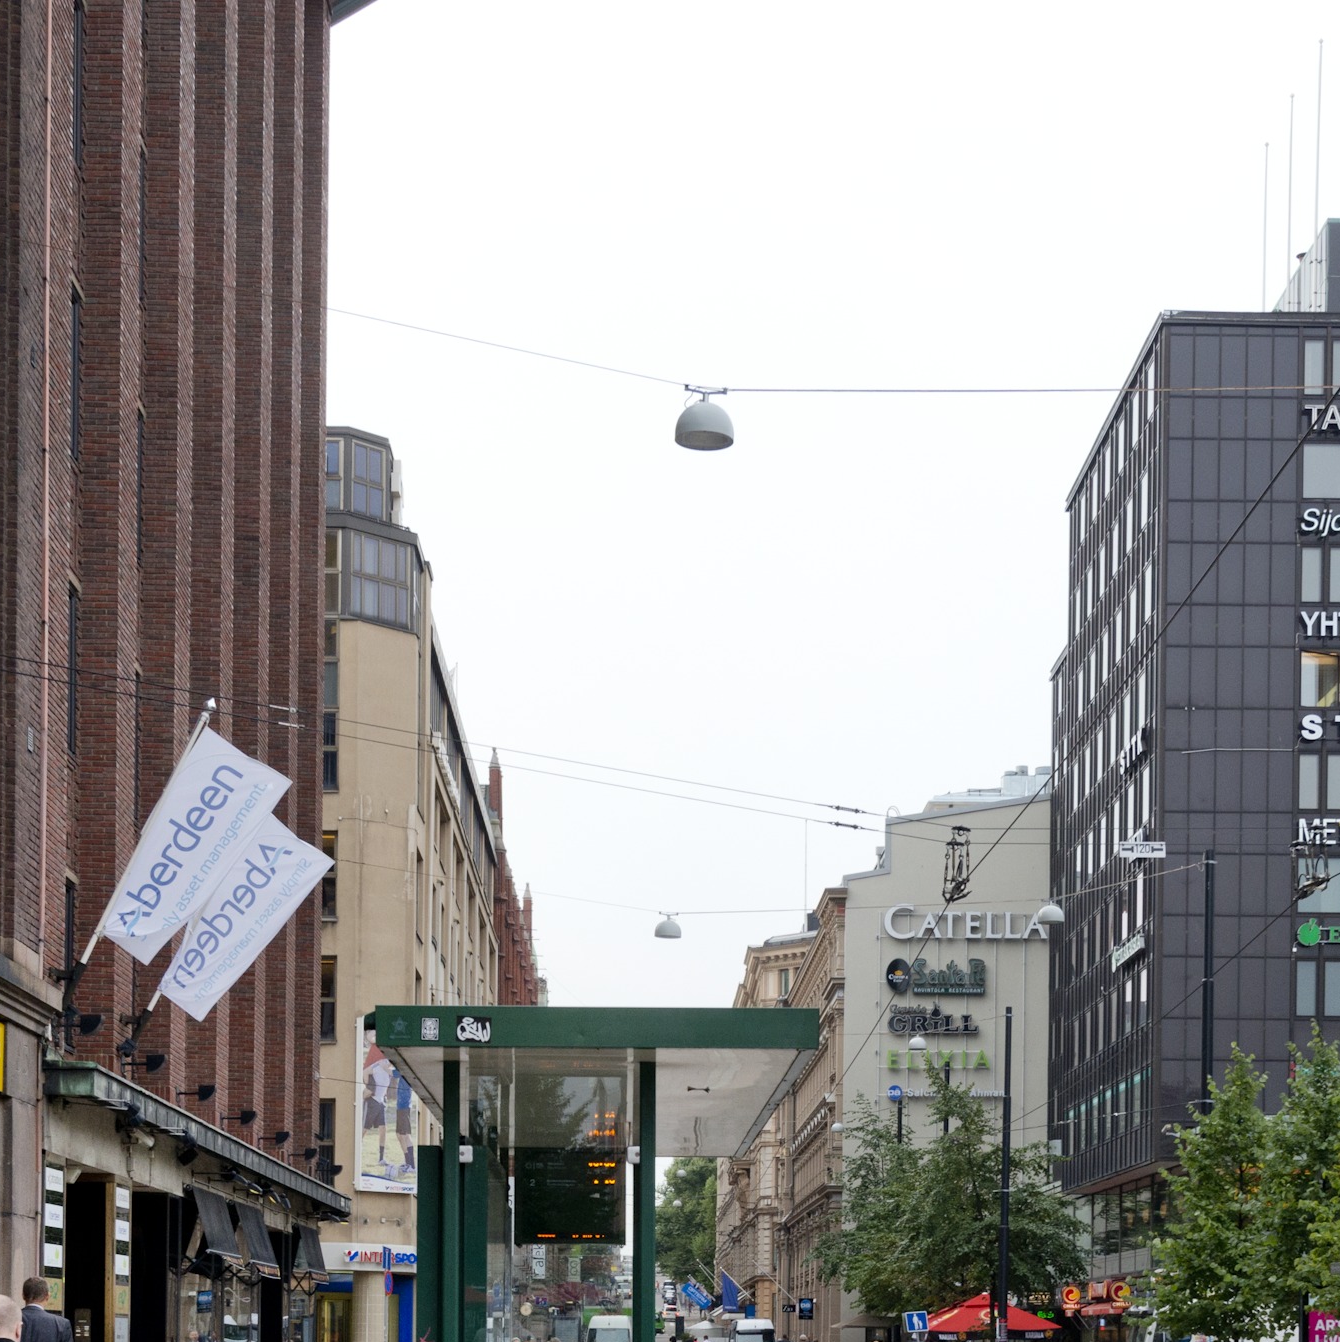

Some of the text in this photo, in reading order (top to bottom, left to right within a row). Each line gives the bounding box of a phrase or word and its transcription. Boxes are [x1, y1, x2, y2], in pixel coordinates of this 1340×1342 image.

[1120, 727, 1144, 776] STTK
[118, 764, 244, 938] Aberdeen
[1135, 844, 1151, 854] 120
[179, 875, 209, 914] asset
[884, 903, 1049, 940] CATELLA
[887, 1050, 991, 1070] ELIXIA
